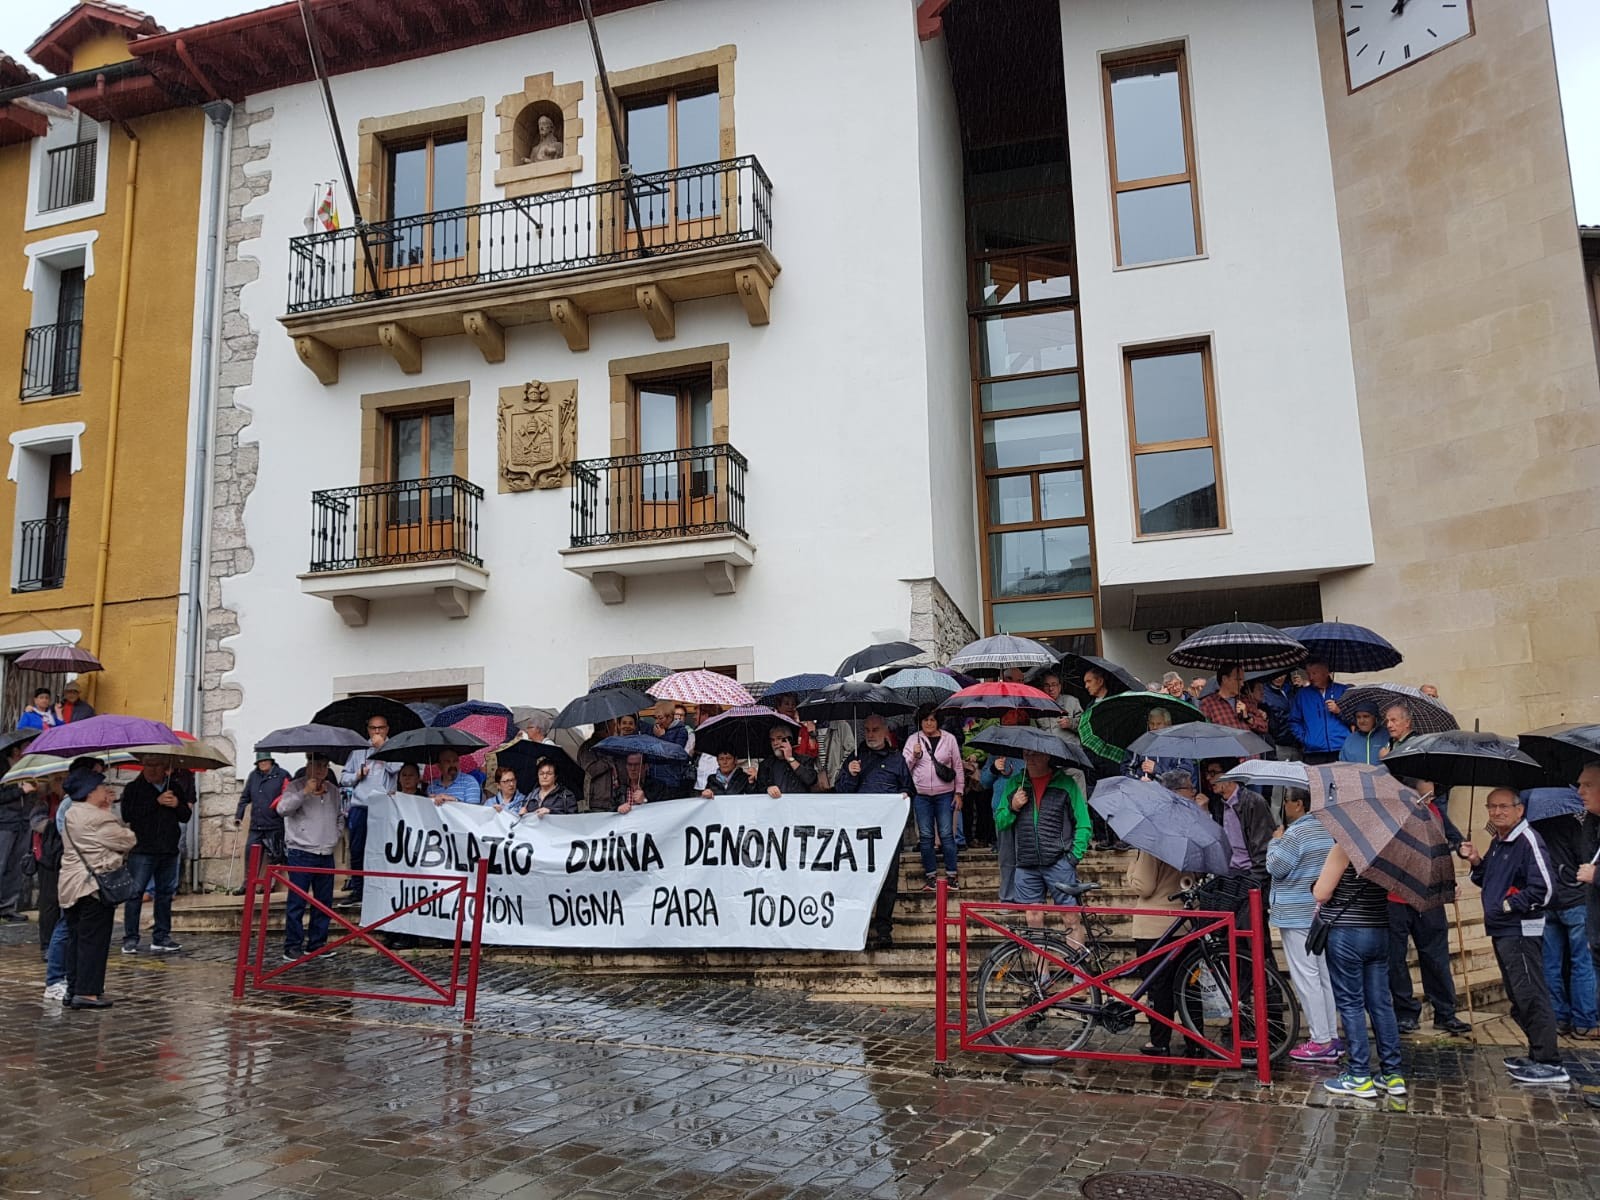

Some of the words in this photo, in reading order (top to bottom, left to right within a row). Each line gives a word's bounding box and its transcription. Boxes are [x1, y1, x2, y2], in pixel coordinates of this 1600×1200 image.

[684, 823, 882, 872] DENONTZAT
[651, 886, 719, 927] PARA
[744, 887, 834, 928] TOD@S
